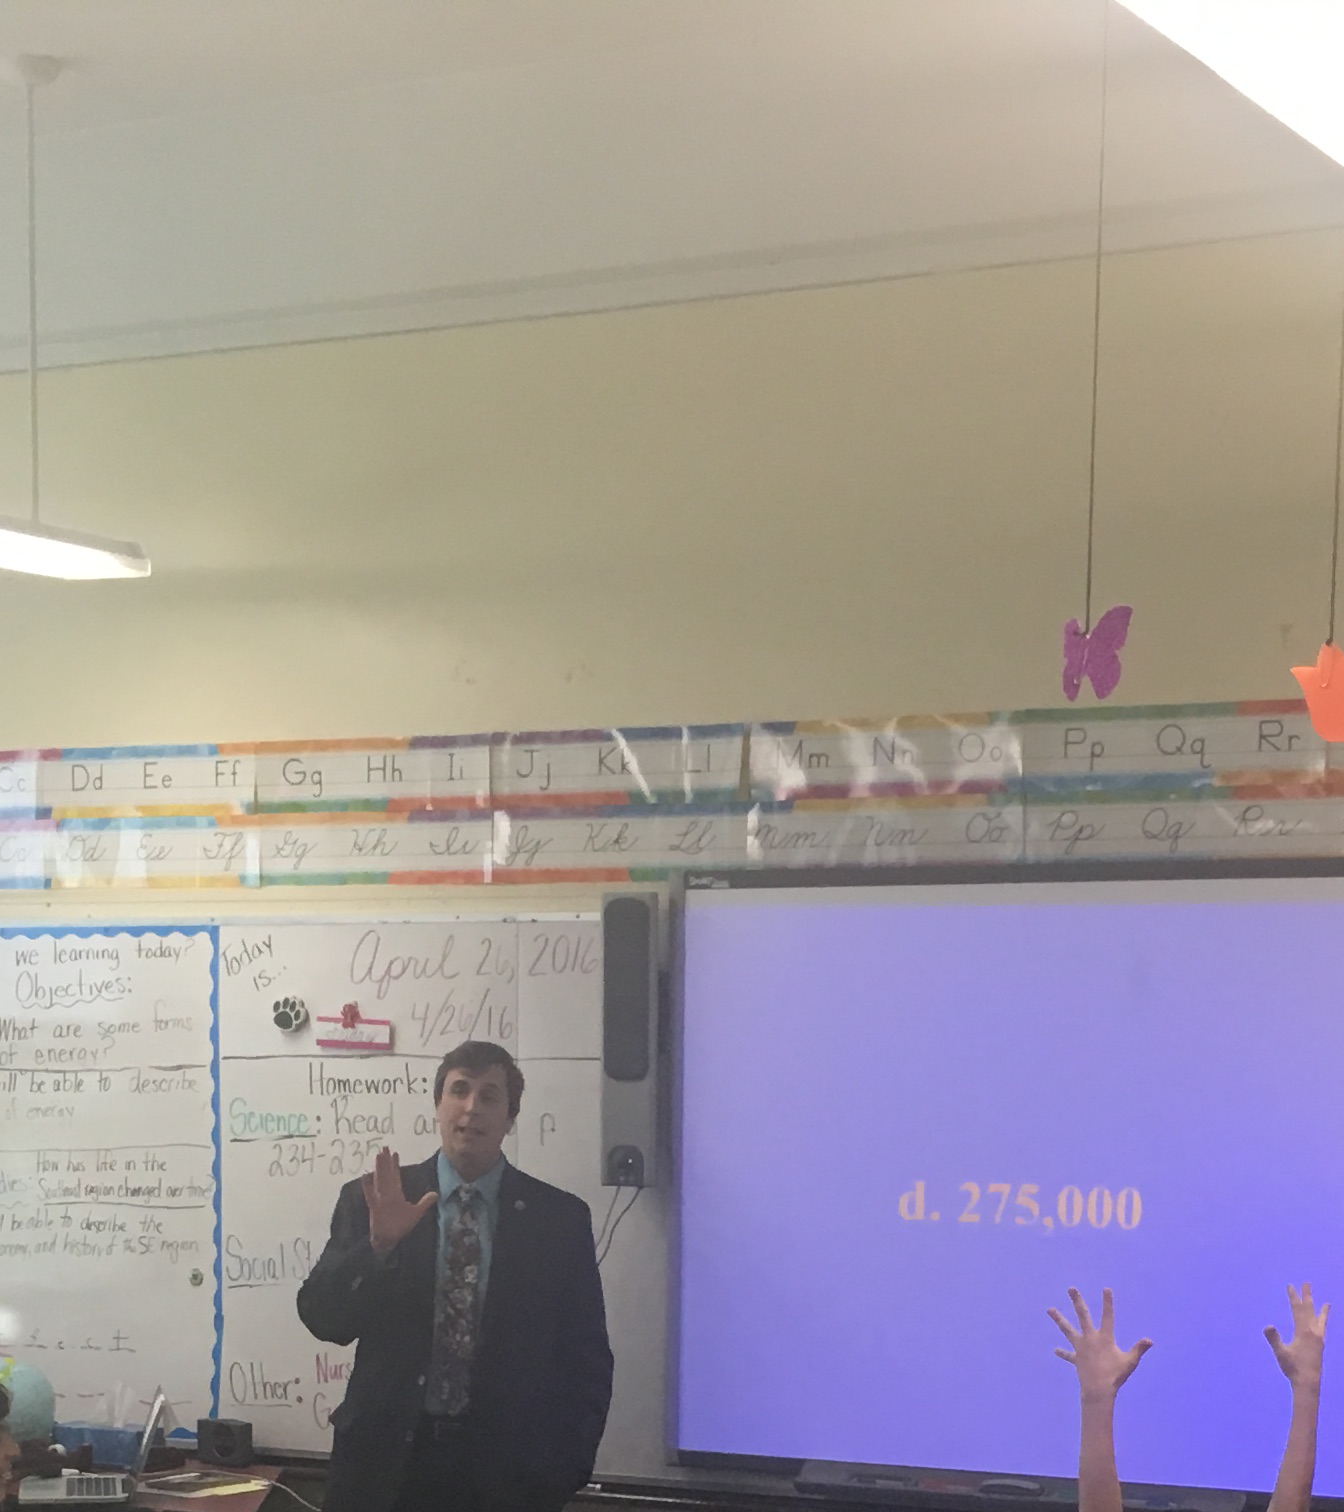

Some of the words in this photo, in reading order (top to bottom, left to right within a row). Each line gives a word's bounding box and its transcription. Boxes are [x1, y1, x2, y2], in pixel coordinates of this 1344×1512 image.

[71, 763, 104, 791] Dd
[143, 762, 173, 789] Ee
[215, 760, 241, 788] Ff
[282, 758, 323, 797] Gg
[366, 756, 403, 783] Hh
[447, 753, 464, 781] Ii
[516, 749, 551, 791] Jj
[597, 747, 632, 775] Kk
[776, 740, 829, 769] Mm
[873, 737, 914, 764] Nn
[959, 733, 1002, 763] Oo
[1063, 728, 1105, 771] Pp
[1157, 724, 1210, 769] Qq
[1258, 720, 1300, 753] Rr
[1047, 807, 1106, 856] Pp
[15, 947, 39, 966] we
[54, 940, 120, 971] learning
[137, 938, 196, 964] today?
[221, 932, 275, 977] Today
[349, 929, 460, 1000] April
[528, 931, 600, 978] 2016
[16, 968, 133, 1009] Objectives:
[53, 1021, 84, 1039] are
[98, 1019, 142, 1040] some
[153, 1000, 194, 1032] forms
[410, 987, 513, 1047] 4/26/16
[30, 1070, 47, 1093] be
[53, 1070, 85, 1093] able
[98, 1070, 112, 1092] to
[128, 1069, 200, 1094] describe
[309, 1061, 428, 1096] Homework:
[229, 1097, 322, 1136] Science:
[333, 1095, 396, 1135] Read
[66, 1151, 86, 1172] has
[95, 1150, 117, 1172] life
[125, 1156, 136, 1171] in
[141, 1151, 168, 1172] the
[59, 1206, 73, 1228] to
[139, 1210, 163, 1233] the
[898, 1180, 940, 1221] d.
[957, 1180, 1143, 1234] 275,000
[226, 1234, 285, 1283] Social
[229, 1361, 303, 1404] Other:
